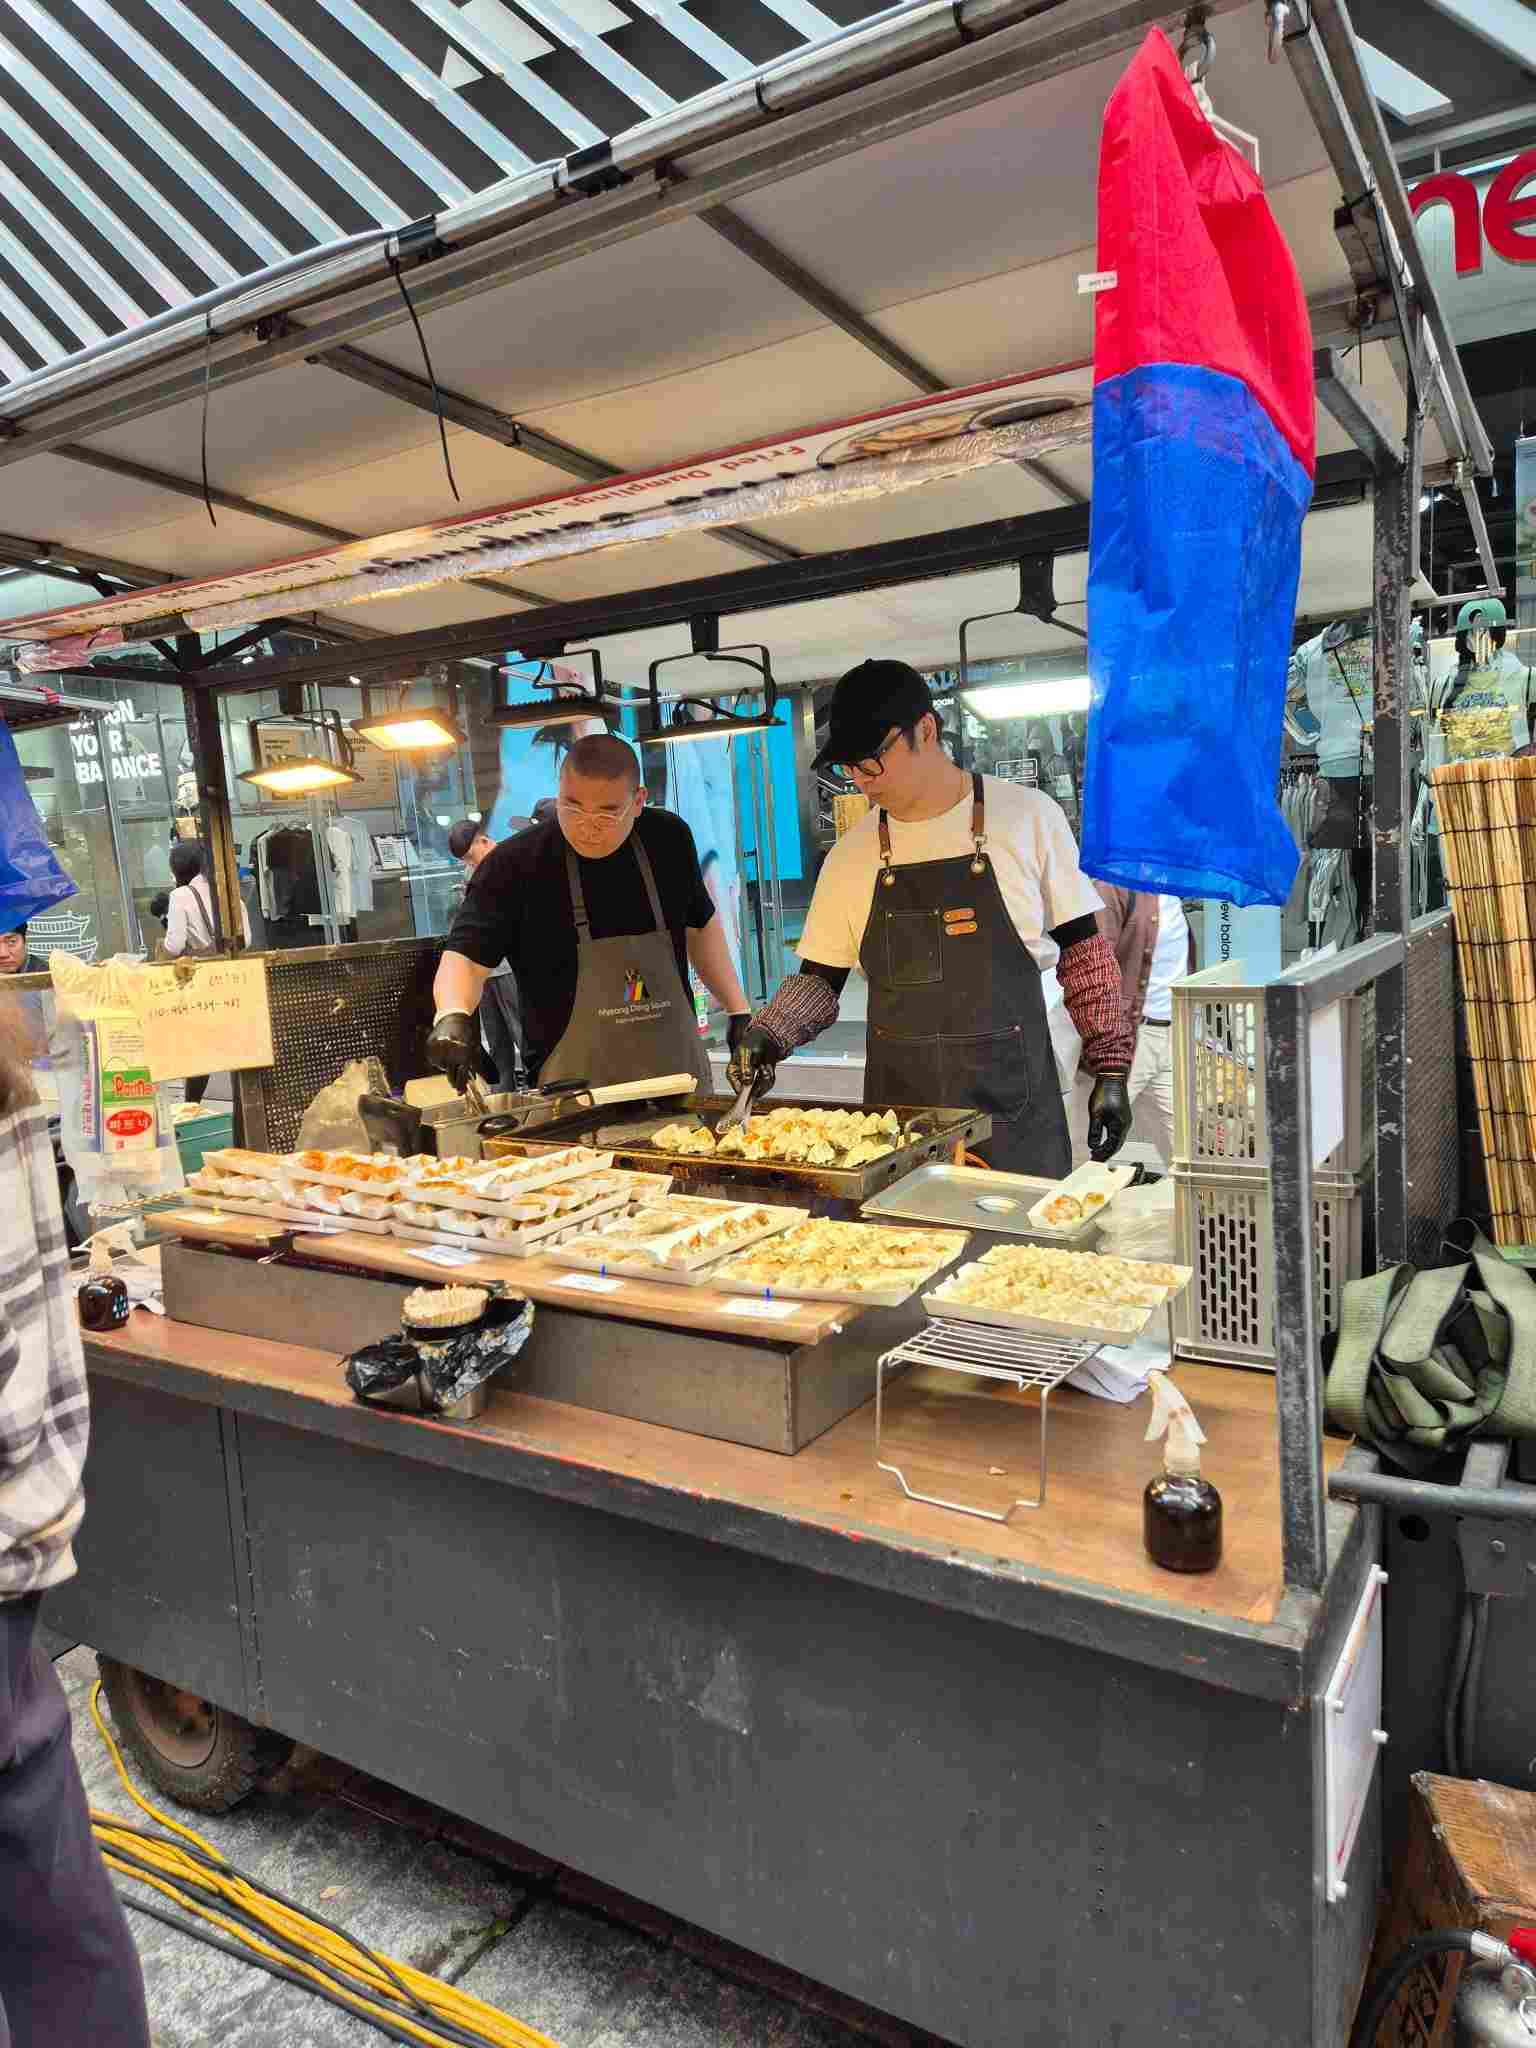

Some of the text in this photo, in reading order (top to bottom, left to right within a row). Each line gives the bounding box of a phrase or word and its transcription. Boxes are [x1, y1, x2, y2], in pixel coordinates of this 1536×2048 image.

[719, 445, 806, 471] Fried
[69, 730, 124, 757] YOR
[73, 751, 162, 784] BAANCE
[1220, 900, 1232, 961] ew balan
